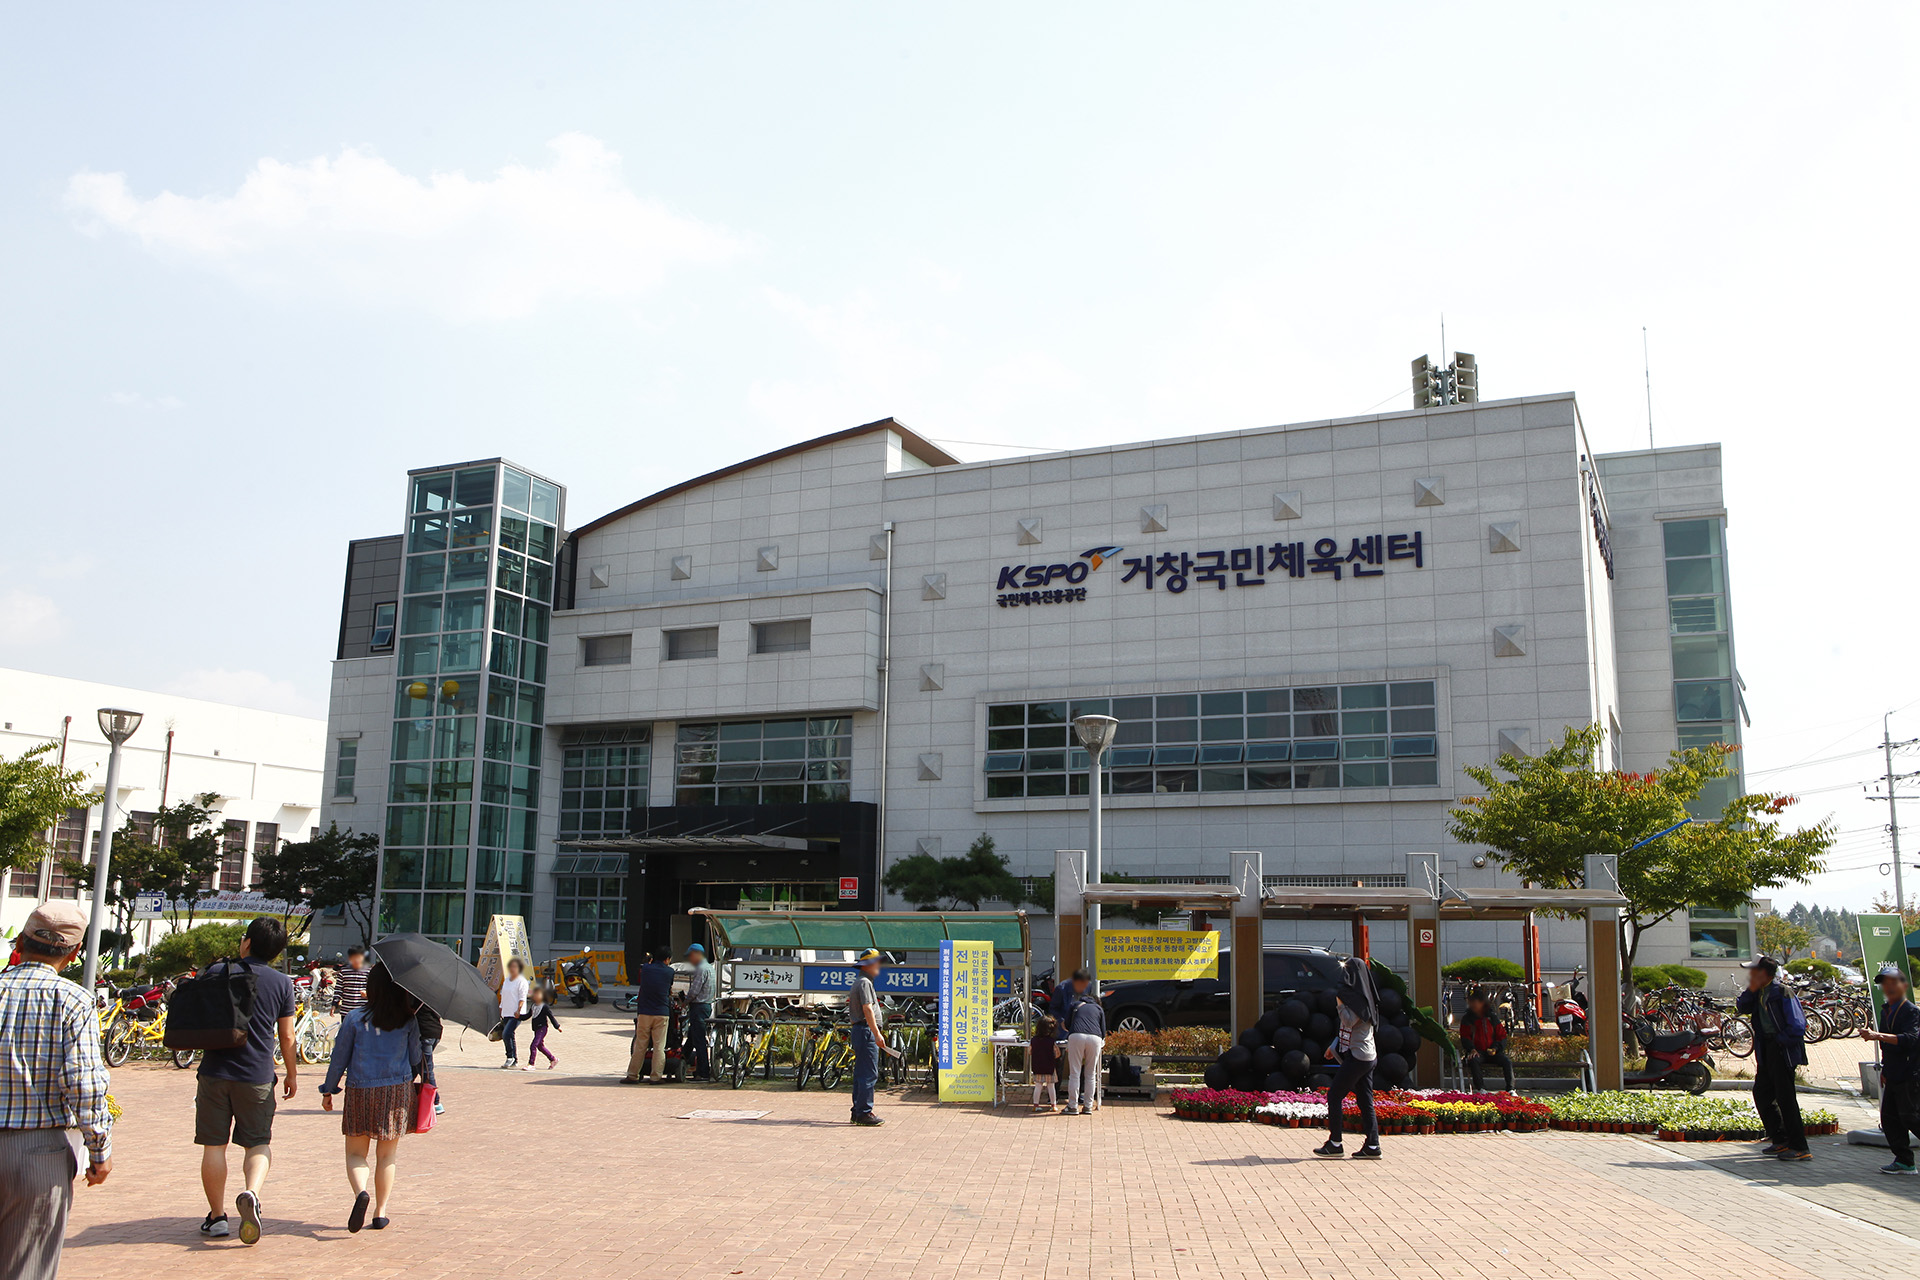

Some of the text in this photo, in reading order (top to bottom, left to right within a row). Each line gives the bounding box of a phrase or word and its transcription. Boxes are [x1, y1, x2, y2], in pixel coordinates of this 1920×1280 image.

[996, 561, 1088, 590] KSPO
[1121, 531, 1424, 594] 거창국민체육센터
[996, 586, 1087, 608] 국민체육진흥공단
[886, 972, 928, 987] 자전거
[955, 950, 969, 1065] 전 세계 서명운동
